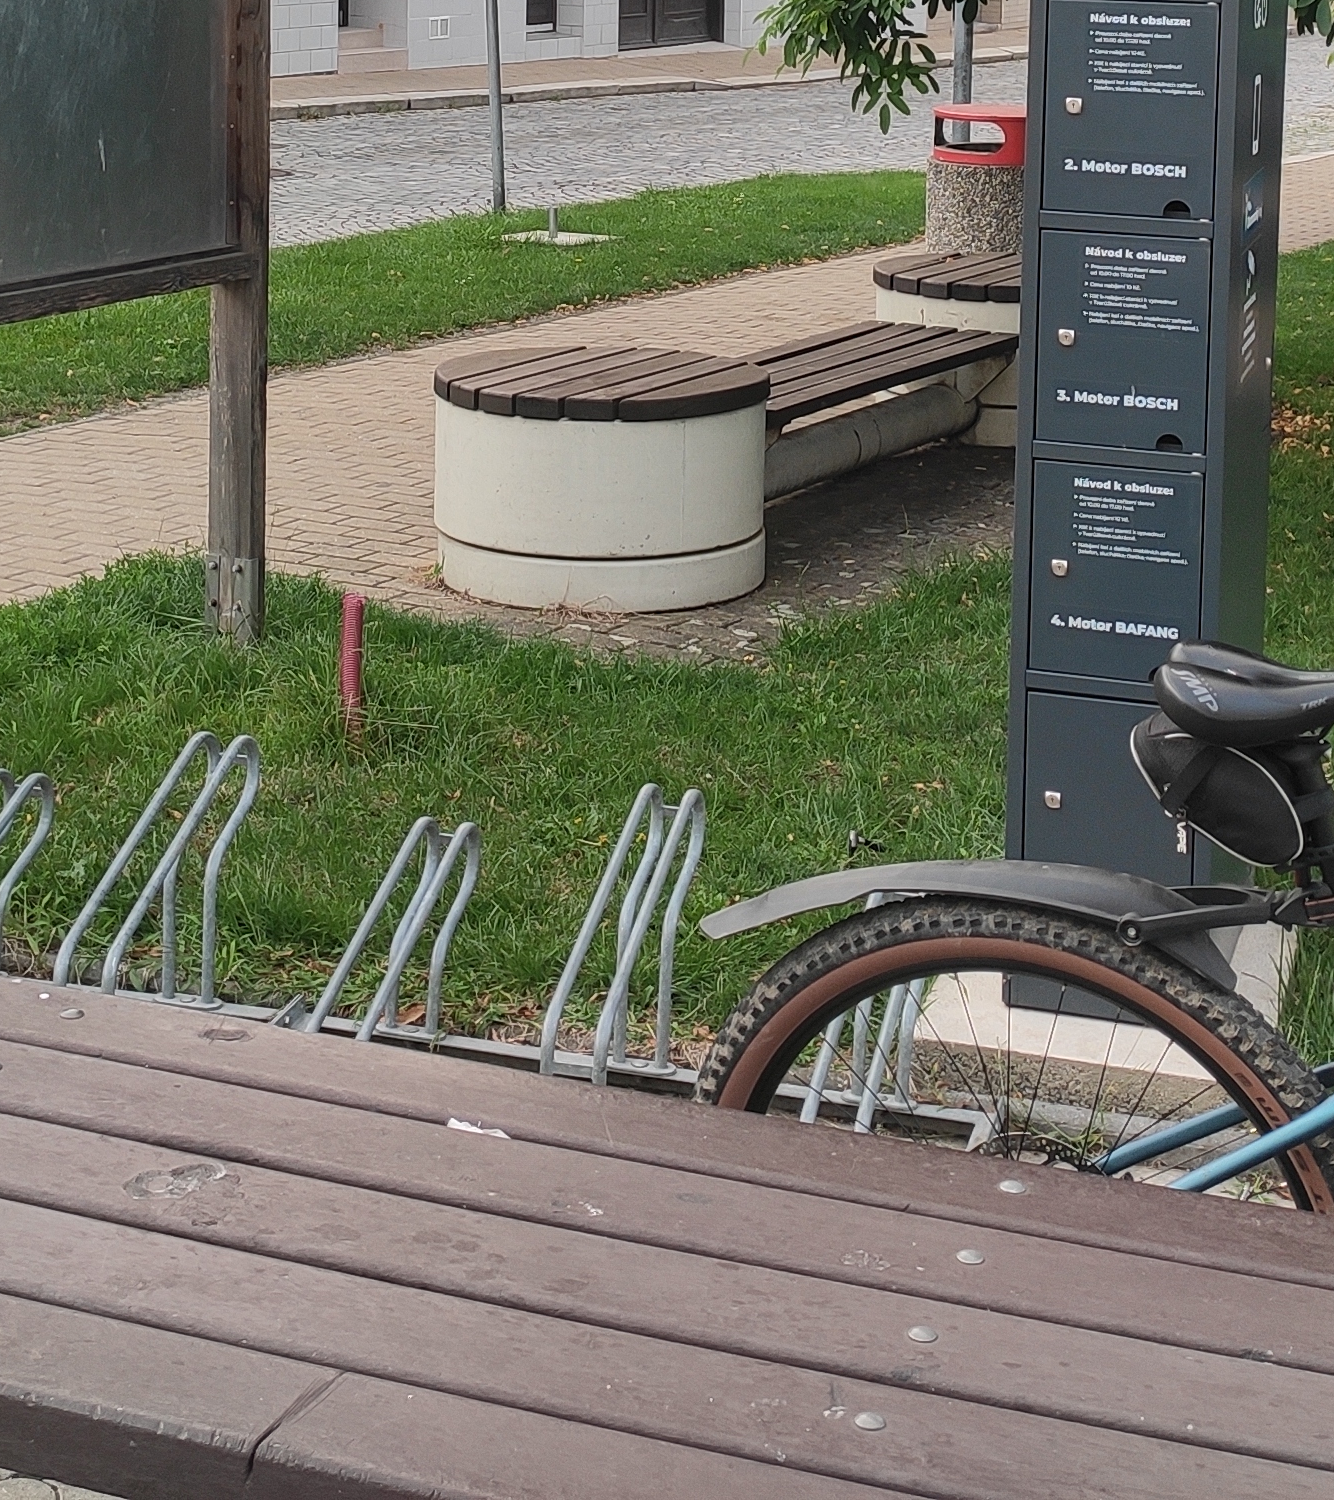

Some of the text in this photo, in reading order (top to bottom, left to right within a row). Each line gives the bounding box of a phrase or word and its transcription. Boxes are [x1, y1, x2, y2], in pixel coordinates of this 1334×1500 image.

[1089, 12, 1128, 25] Návod
[1130, 14, 1138, 25] k
[1064, 159, 1187, 178] 2. Motor BOSCH
[1085, 246, 1123, 259] Návod
[1125, 249, 1133, 259] k
[1056, 389, 1179, 411] 3. Motor BOSCH
[1074, 477, 1111, 490] Návod
[1113, 480, 1122, 491] k
[1050, 614, 1179, 639] 4. Motor BAFANG
[1170, 668, 1219, 712] SMP
